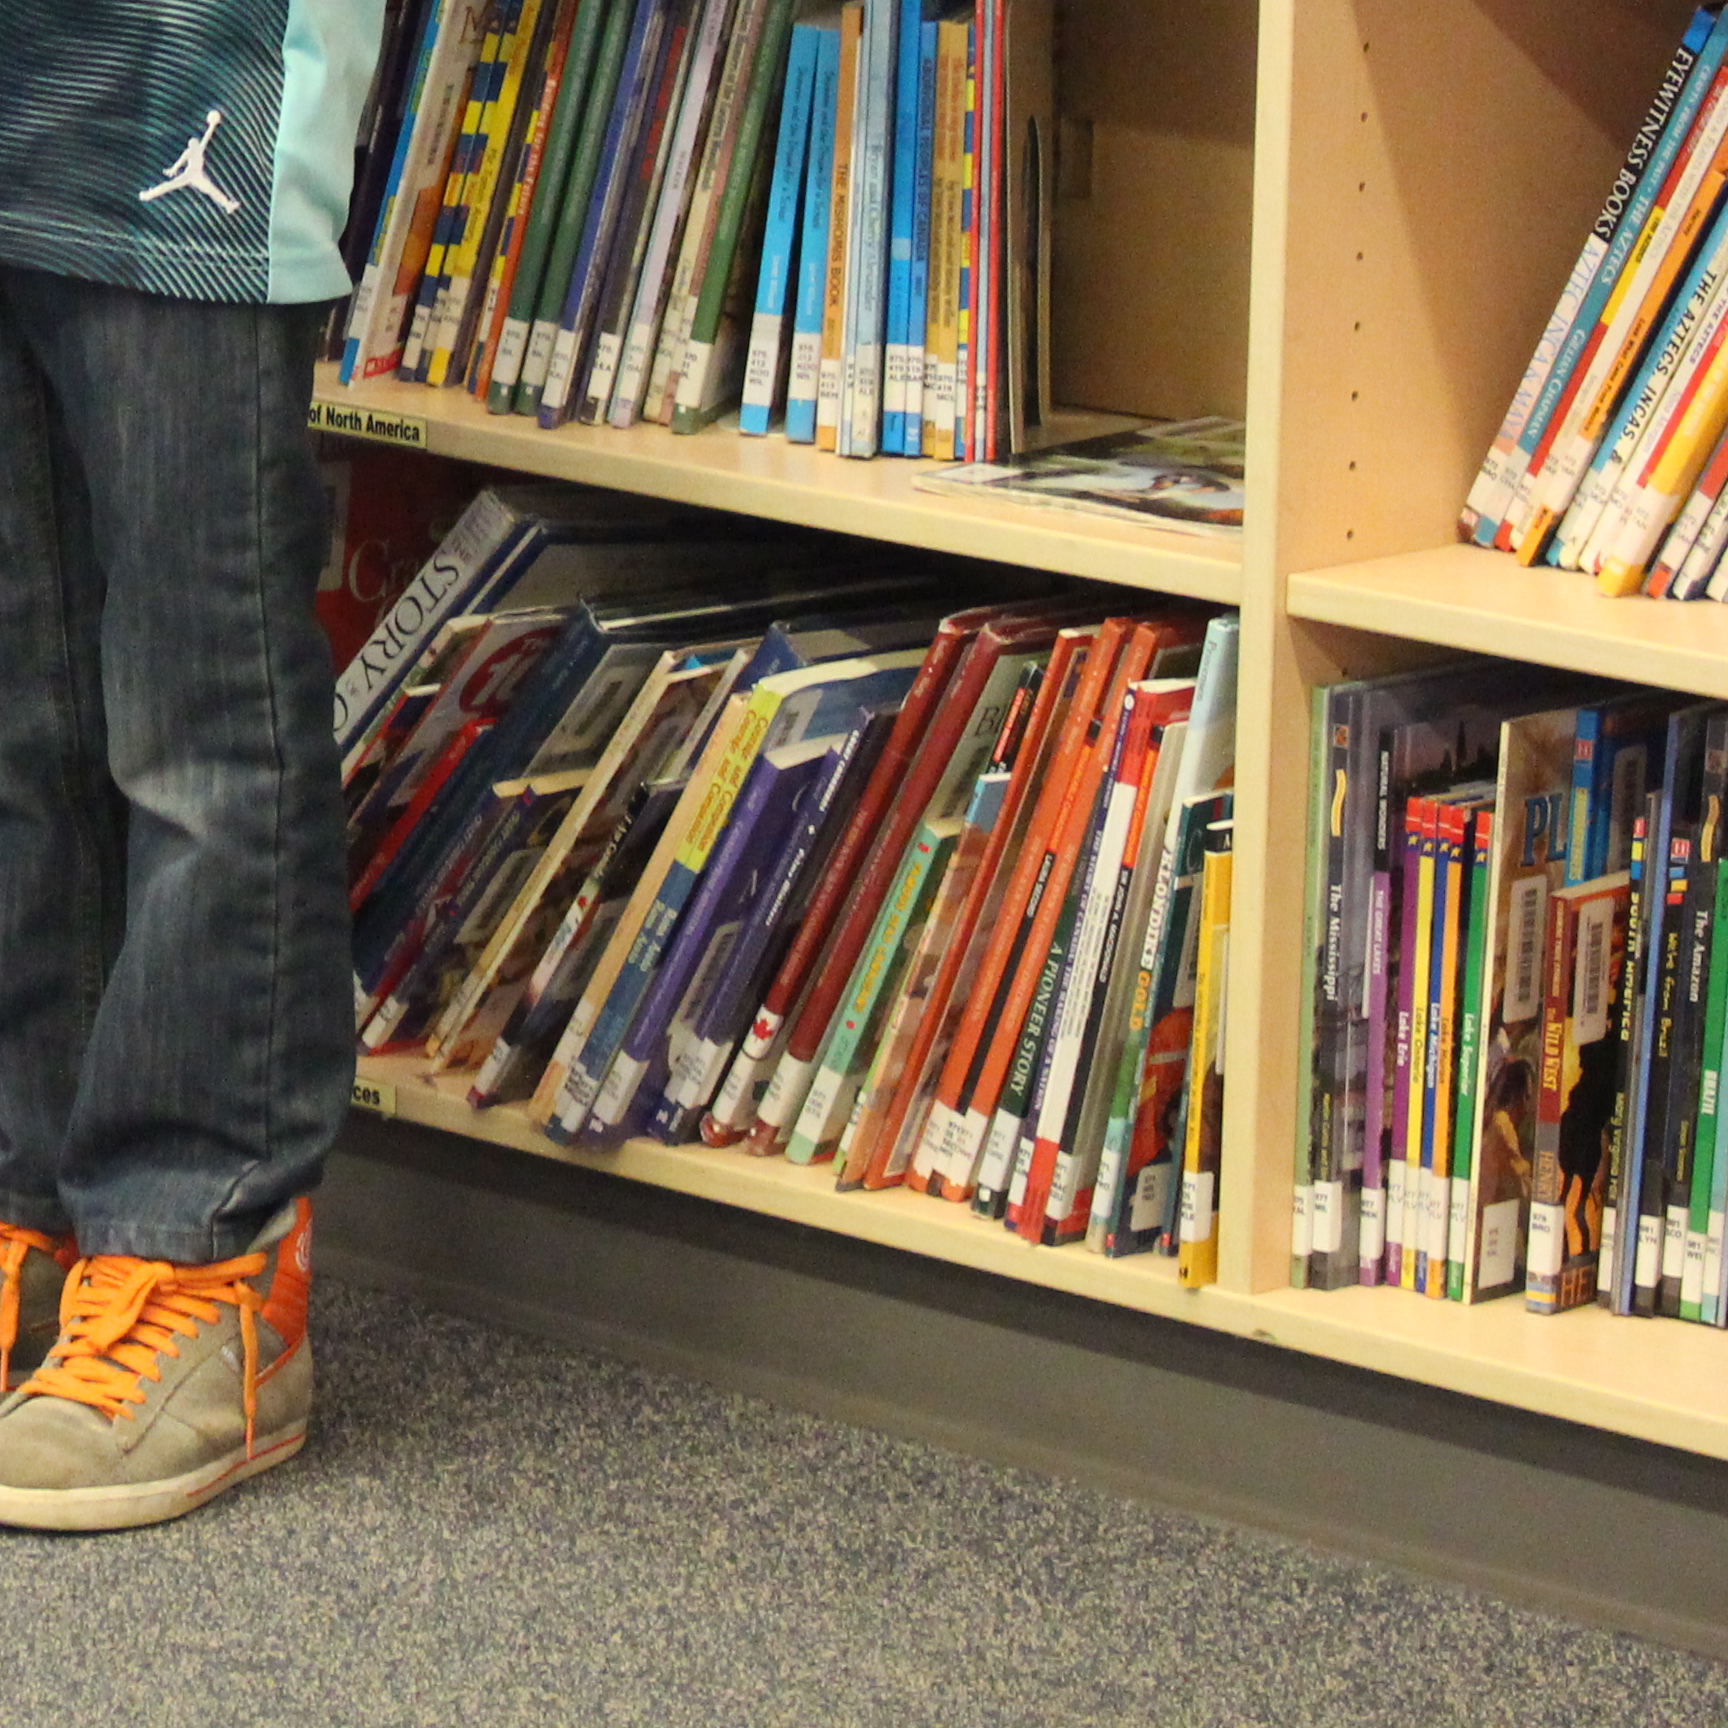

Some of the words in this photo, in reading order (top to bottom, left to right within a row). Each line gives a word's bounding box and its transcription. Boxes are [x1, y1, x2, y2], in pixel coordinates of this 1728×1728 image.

[1627, 47, 1695, 170] EYEWITNESS
[838, 163, 850, 186] THE
[831, 188, 848, 263] MISHOMIS
[1594, 168, 1638, 240] BOOKS
[1627, 193, 1651, 227] THE
[863, 245, 877, 312] Alexander
[1600, 229, 1635, 286] AZTECS
[827, 265, 842, 308] BOOK
[1695, 269, 1717, 305] THE
[1646, 306, 1698, 378] AZTECS,
[1688, 326, 1715, 366] AZTECS
[325, 408, 363, 434] North
[365, 414, 421, 443] America
[1529, 378, 1563, 440] CHAPMAN
[1619, 388, 1658, 447] INCAS,
[1608, 448, 1623, 468] &
[359, 552, 461, 692] STORY
[1329, 883, 1343, 913] The
[1694, 909, 1708, 937] The
[1325, 914, 1342, 1002] Mississippi
[1689, 939, 1705, 1003] Amazon
[1032, 959, 1060, 1033] PIONEER
[1129, 971, 1151, 1031] GOLD
[1660, 975, 1675, 1010] from
[1399, 1010, 1410, 1039] Lake
[1430, 1002, 1441, 1027] Lake
[1463, 1011, 1475, 1041] Lake
[1396, 1040, 1408, 1067] Erie
[1425, 1028, 1439, 1089] Michigan
[1658, 1017, 1672, 1058] Brazil
[1009, 1036, 1039, 1098] STORY
[1460, 1042, 1474, 1097] Superior
[1542, 1055, 1558, 1092] WEST
[352, 1083, 381, 1105] ces
